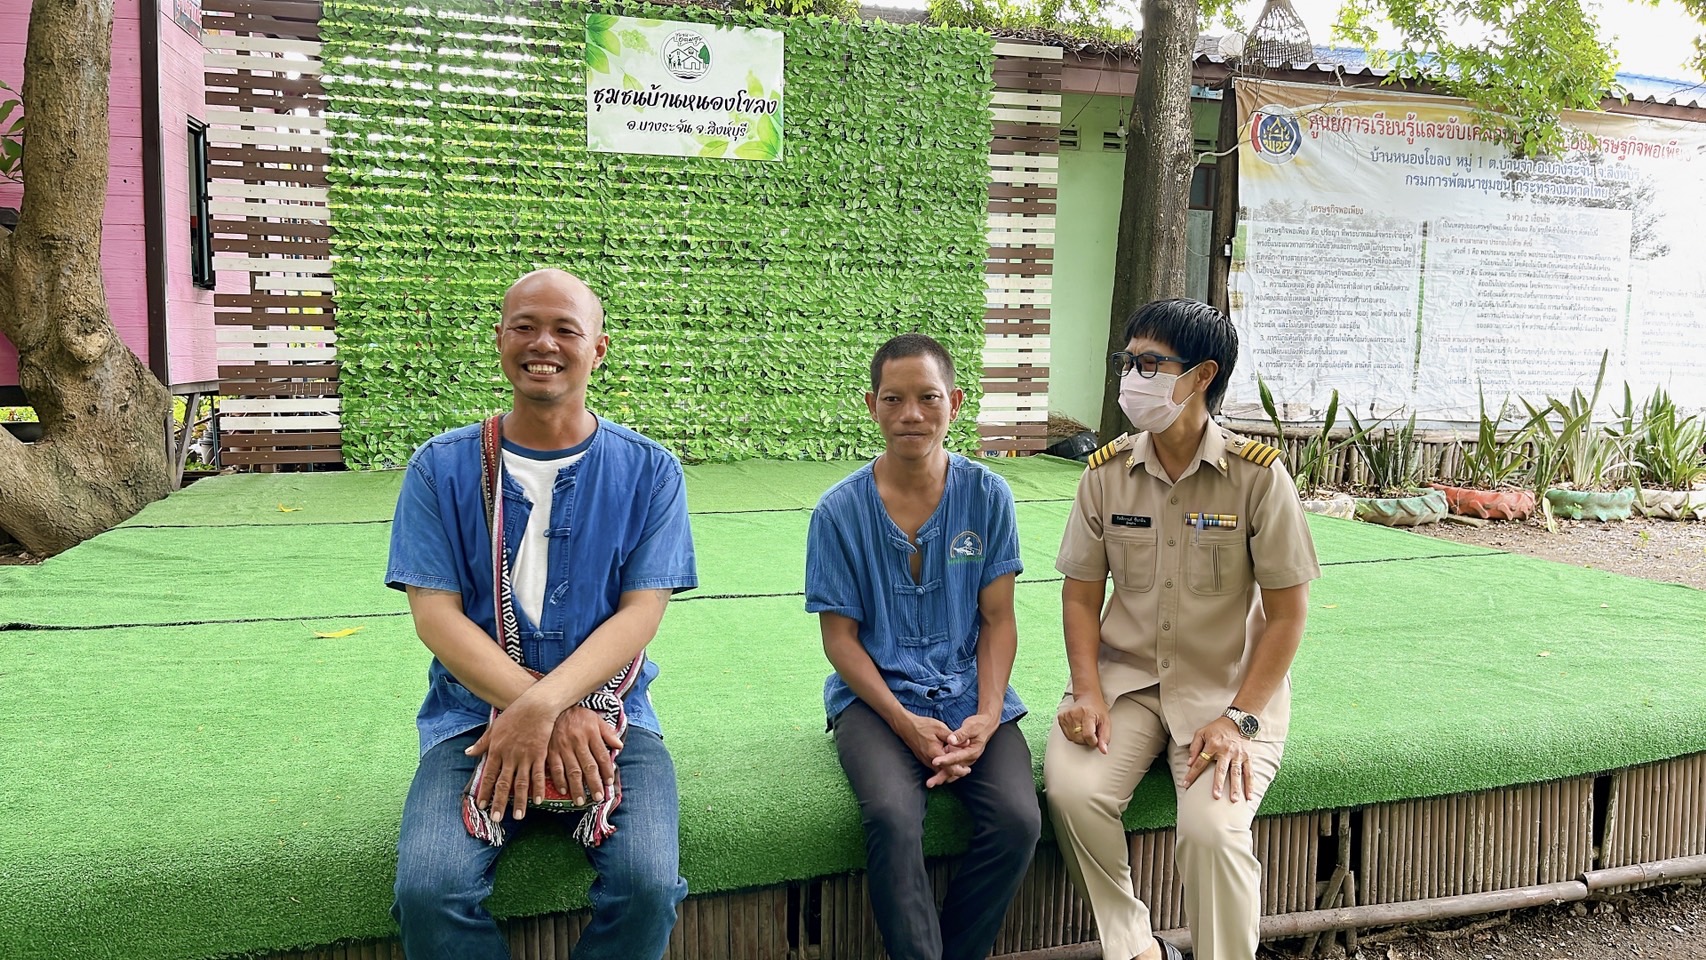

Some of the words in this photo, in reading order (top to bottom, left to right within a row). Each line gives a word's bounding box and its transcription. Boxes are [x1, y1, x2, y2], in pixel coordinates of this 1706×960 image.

[593, 84, 778, 115] ชุมชนบ้านหนองโขลง
[626, 119, 693, 134] อ.บางระจัน
[696, 121, 748, 141] จ.สิงห์บุรี
[1370, 146, 1451, 167] บ้านหนองโขลง
[1456, 153, 1472, 173] หมู่
[1477, 156, 1483, 169] 1
[1537, 160, 1594, 177] อ.บางระจัน
[1405, 172, 1511, 195] กรมการพัฒนาชุมชน
[1515, 179, 1609, 199] กระทรวงมหาดไทย
[1311, 204, 1364, 216] เศรษฐกิจพอเพียง
